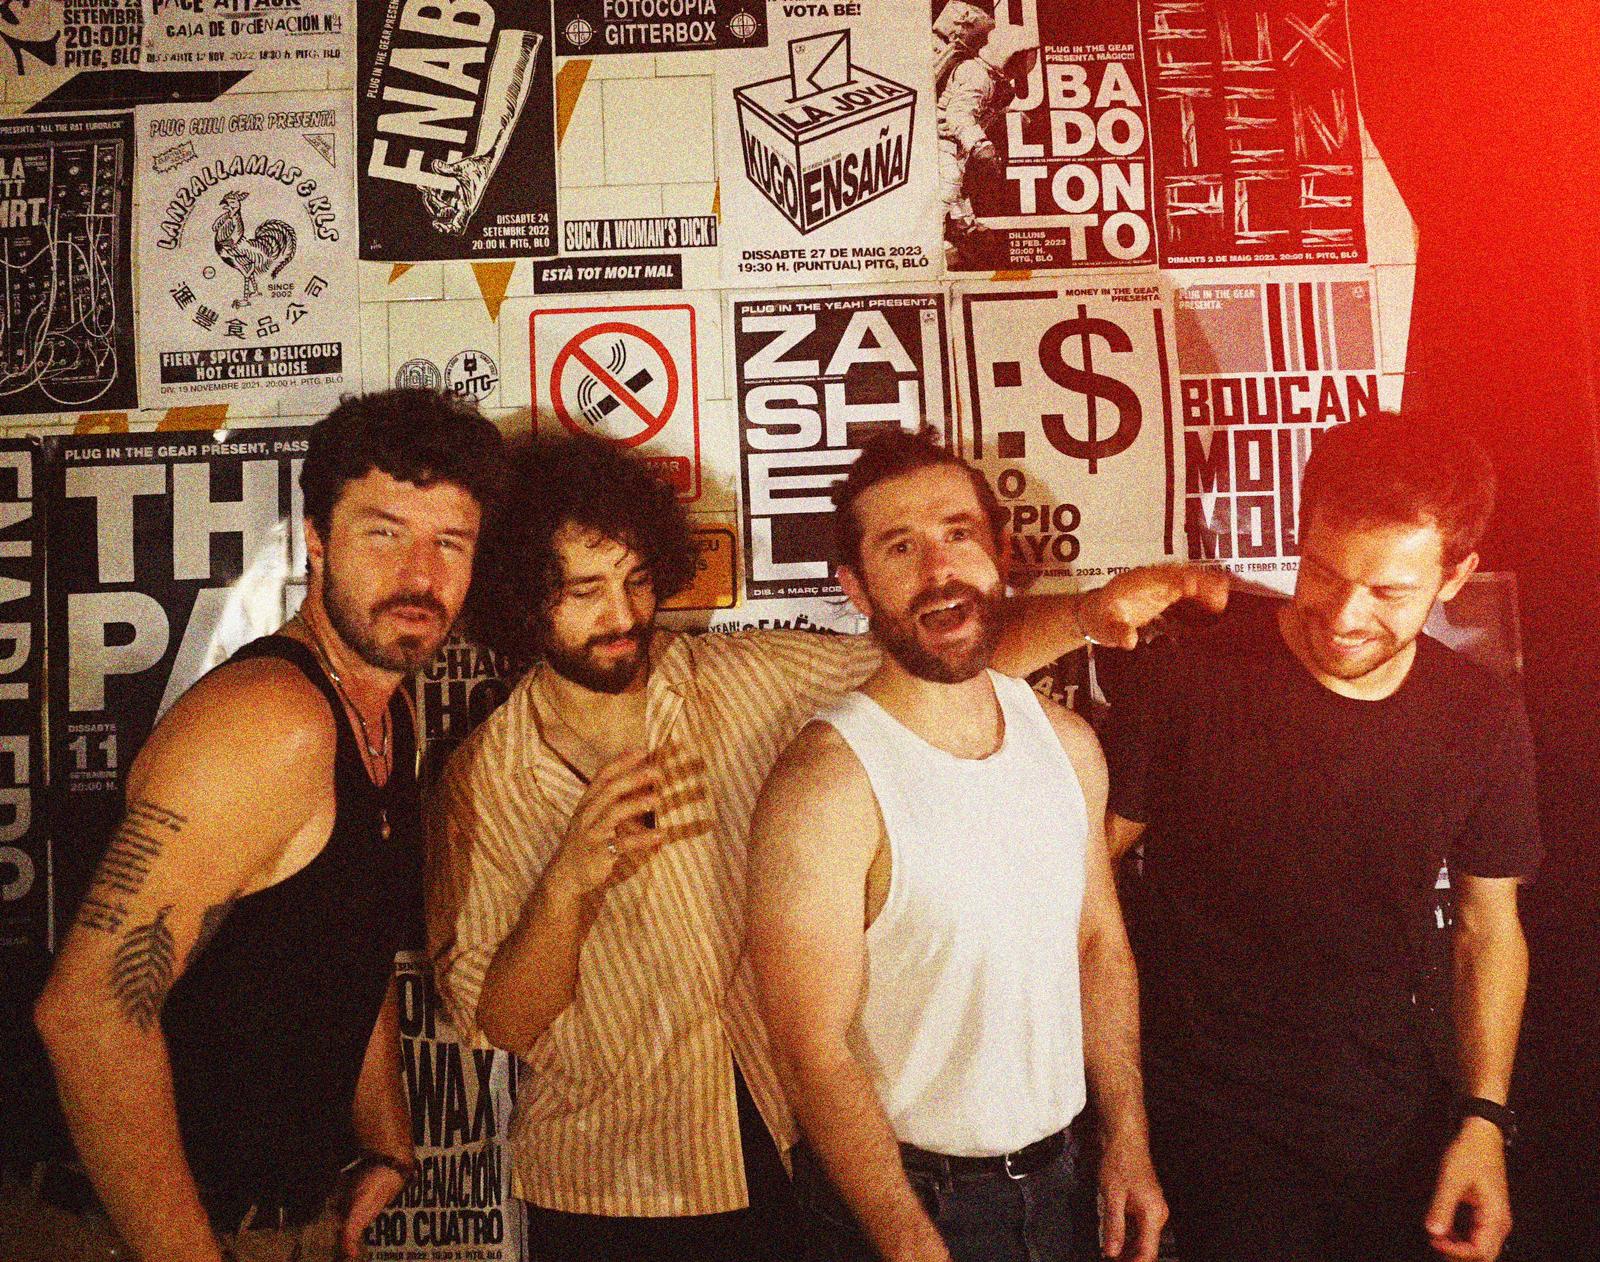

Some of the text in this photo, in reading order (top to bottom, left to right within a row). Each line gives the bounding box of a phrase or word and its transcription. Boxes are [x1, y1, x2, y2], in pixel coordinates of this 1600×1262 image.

[602, 0, 717, 19] FOTOCOPIA
[782, 4, 828, 18] VOTA
[209, 20, 226, 37] DE
[605, 21, 718, 47] GITTERBOX
[832, 84, 904, 112] JOYA
[150, 110, 336, 138] PLUG CHILI GEAR PRESENTA
[746, 129, 798, 219] KUGO
[803, 125, 903, 227] ENSAÑA
[1006, 162, 1146, 214] TON
[157, 154, 302, 250] LANZALLAMAS
[308, 196, 339, 242] KLS
[538, 213, 550, 223] 24
[529, 225, 550, 236] 2022
[566, 219, 600, 251] SUCK
[603, 221, 612, 249] A
[615, 218, 677, 249] WOMAN'S
[742, 250, 806, 261] DISSABTE
[810, 249, 826, 259] 27
[830, 248, 849, 258] DE
[853, 247, 886, 258] MAIG
[542, 265, 674, 282] ESTÀ TOT MOLT MAL
[738, 262, 773, 273] 19:30
[777, 261, 790, 272] H.
[794, 260, 862, 273] (PUNTUAL)
[865, 258, 899, 270] PITG,
[267, 283, 295, 291] SINCE
[271, 290, 292, 298] 2002
[1066, 288, 1098, 296] MONEY
[1112, 287, 1132, 295] THE
[1134, 286, 1160, 294] GEAR
[741, 298, 937, 314] PLUG IN THE YEAH! PRESENTA
[1111, 294, 1160, 302] PRESENTA
[741, 309, 918, 380] ZA
[163, 344, 339, 367] FIERY, SPICY & DELICIOUS
[196, 361, 308, 380] HOT CHILI NOISE
[190, 383, 239, 393] NOVEMBRE
[1180, 374, 1380, 427] BOUCAN
[65, 449, 101, 461] PLUG
[106, 448, 120, 459] IN
[125, 447, 153, 459] THE
[158, 446, 197, 457] GEAR
[201, 442, 269, 456] PRESENT,
[788, 586, 818, 597] MARÇ
[68, 735, 118, 769] 11
[403, 1039, 497, 1148] WAX
[413, 1208, 504, 1246] CUATRO
